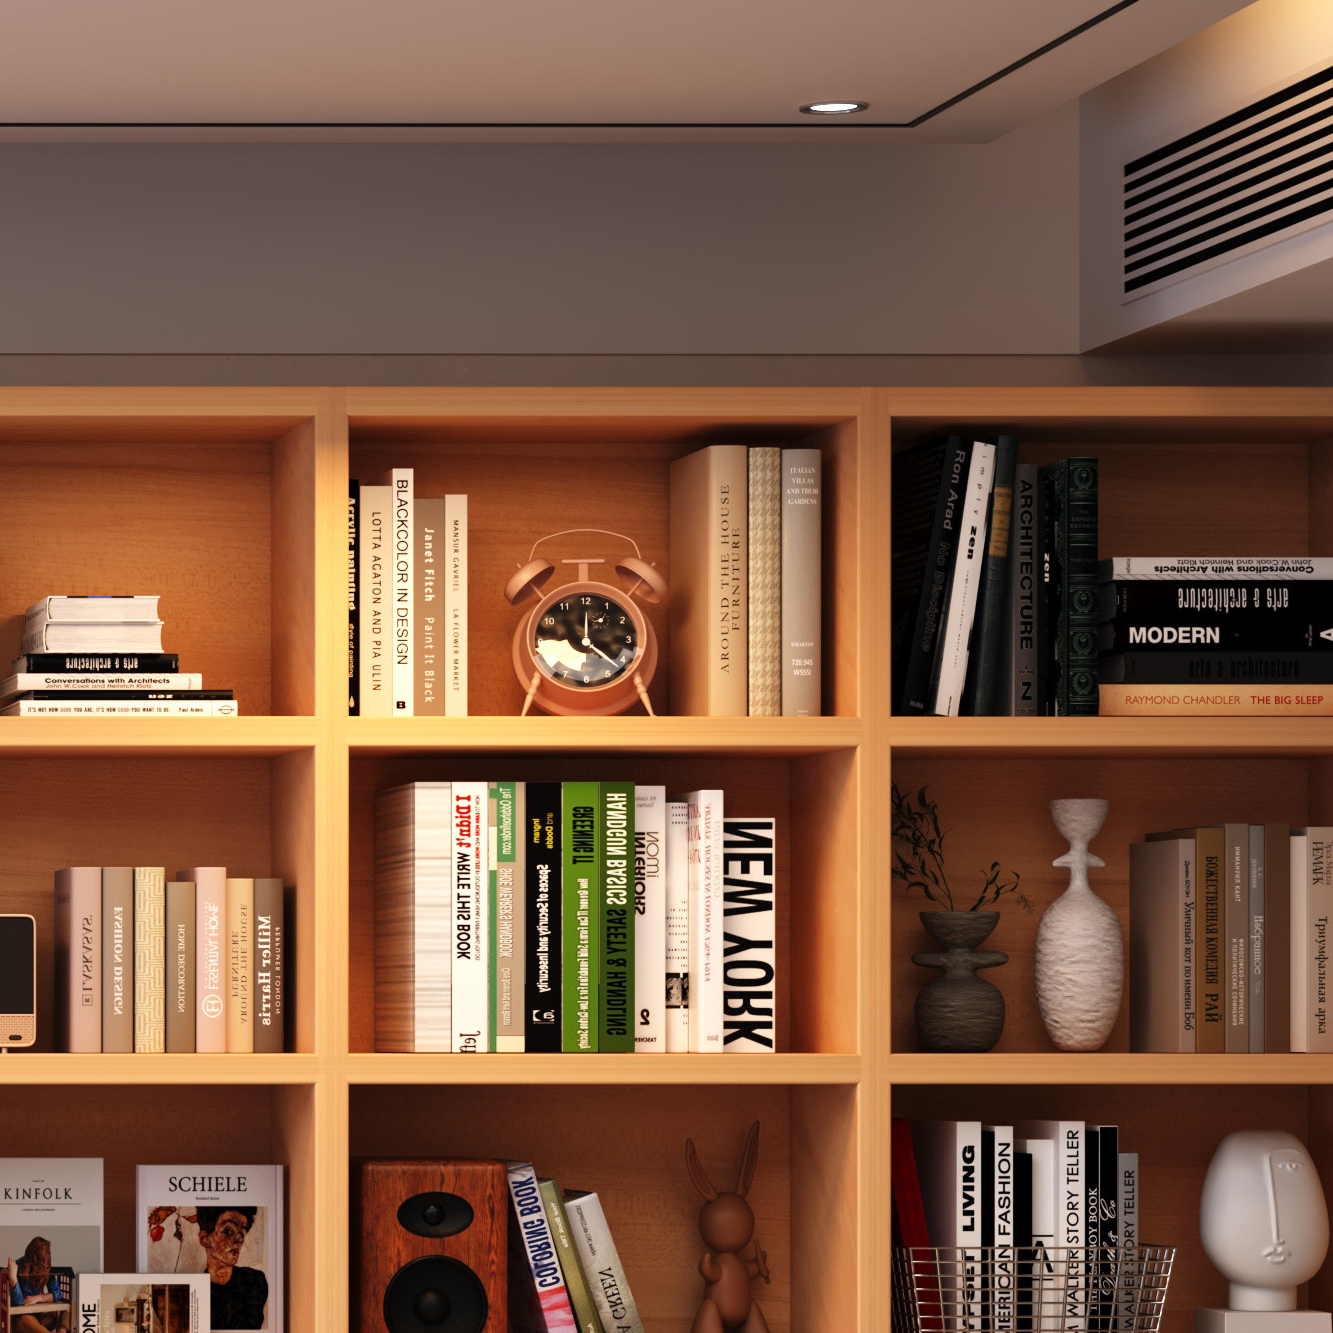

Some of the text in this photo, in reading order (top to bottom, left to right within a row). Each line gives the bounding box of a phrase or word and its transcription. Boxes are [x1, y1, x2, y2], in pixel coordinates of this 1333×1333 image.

[942, 449, 966, 530] Ron Arad
[372, 512, 381, 691] LOTTA AGATON AND PIA ULIN
[396, 479, 408, 665] BLACKCOLOR IN DESIGN
[1020, 479, 1033, 650] ARCHITECTURE
[424, 528, 435, 703] Janet Fitch Paint It Black
[1129, 627, 1220, 644] MODERN
[1125, 696, 1323, 705] RAYMOND CHANDLER THE BIG SLEEP
[4, 1187, 73, 1200] KINFOLK
[168, 1176, 248, 1193] SCHIELE
[962, 1145, 975, 1232] LIVING
[998, 1142, 1011, 1236] FASHION
